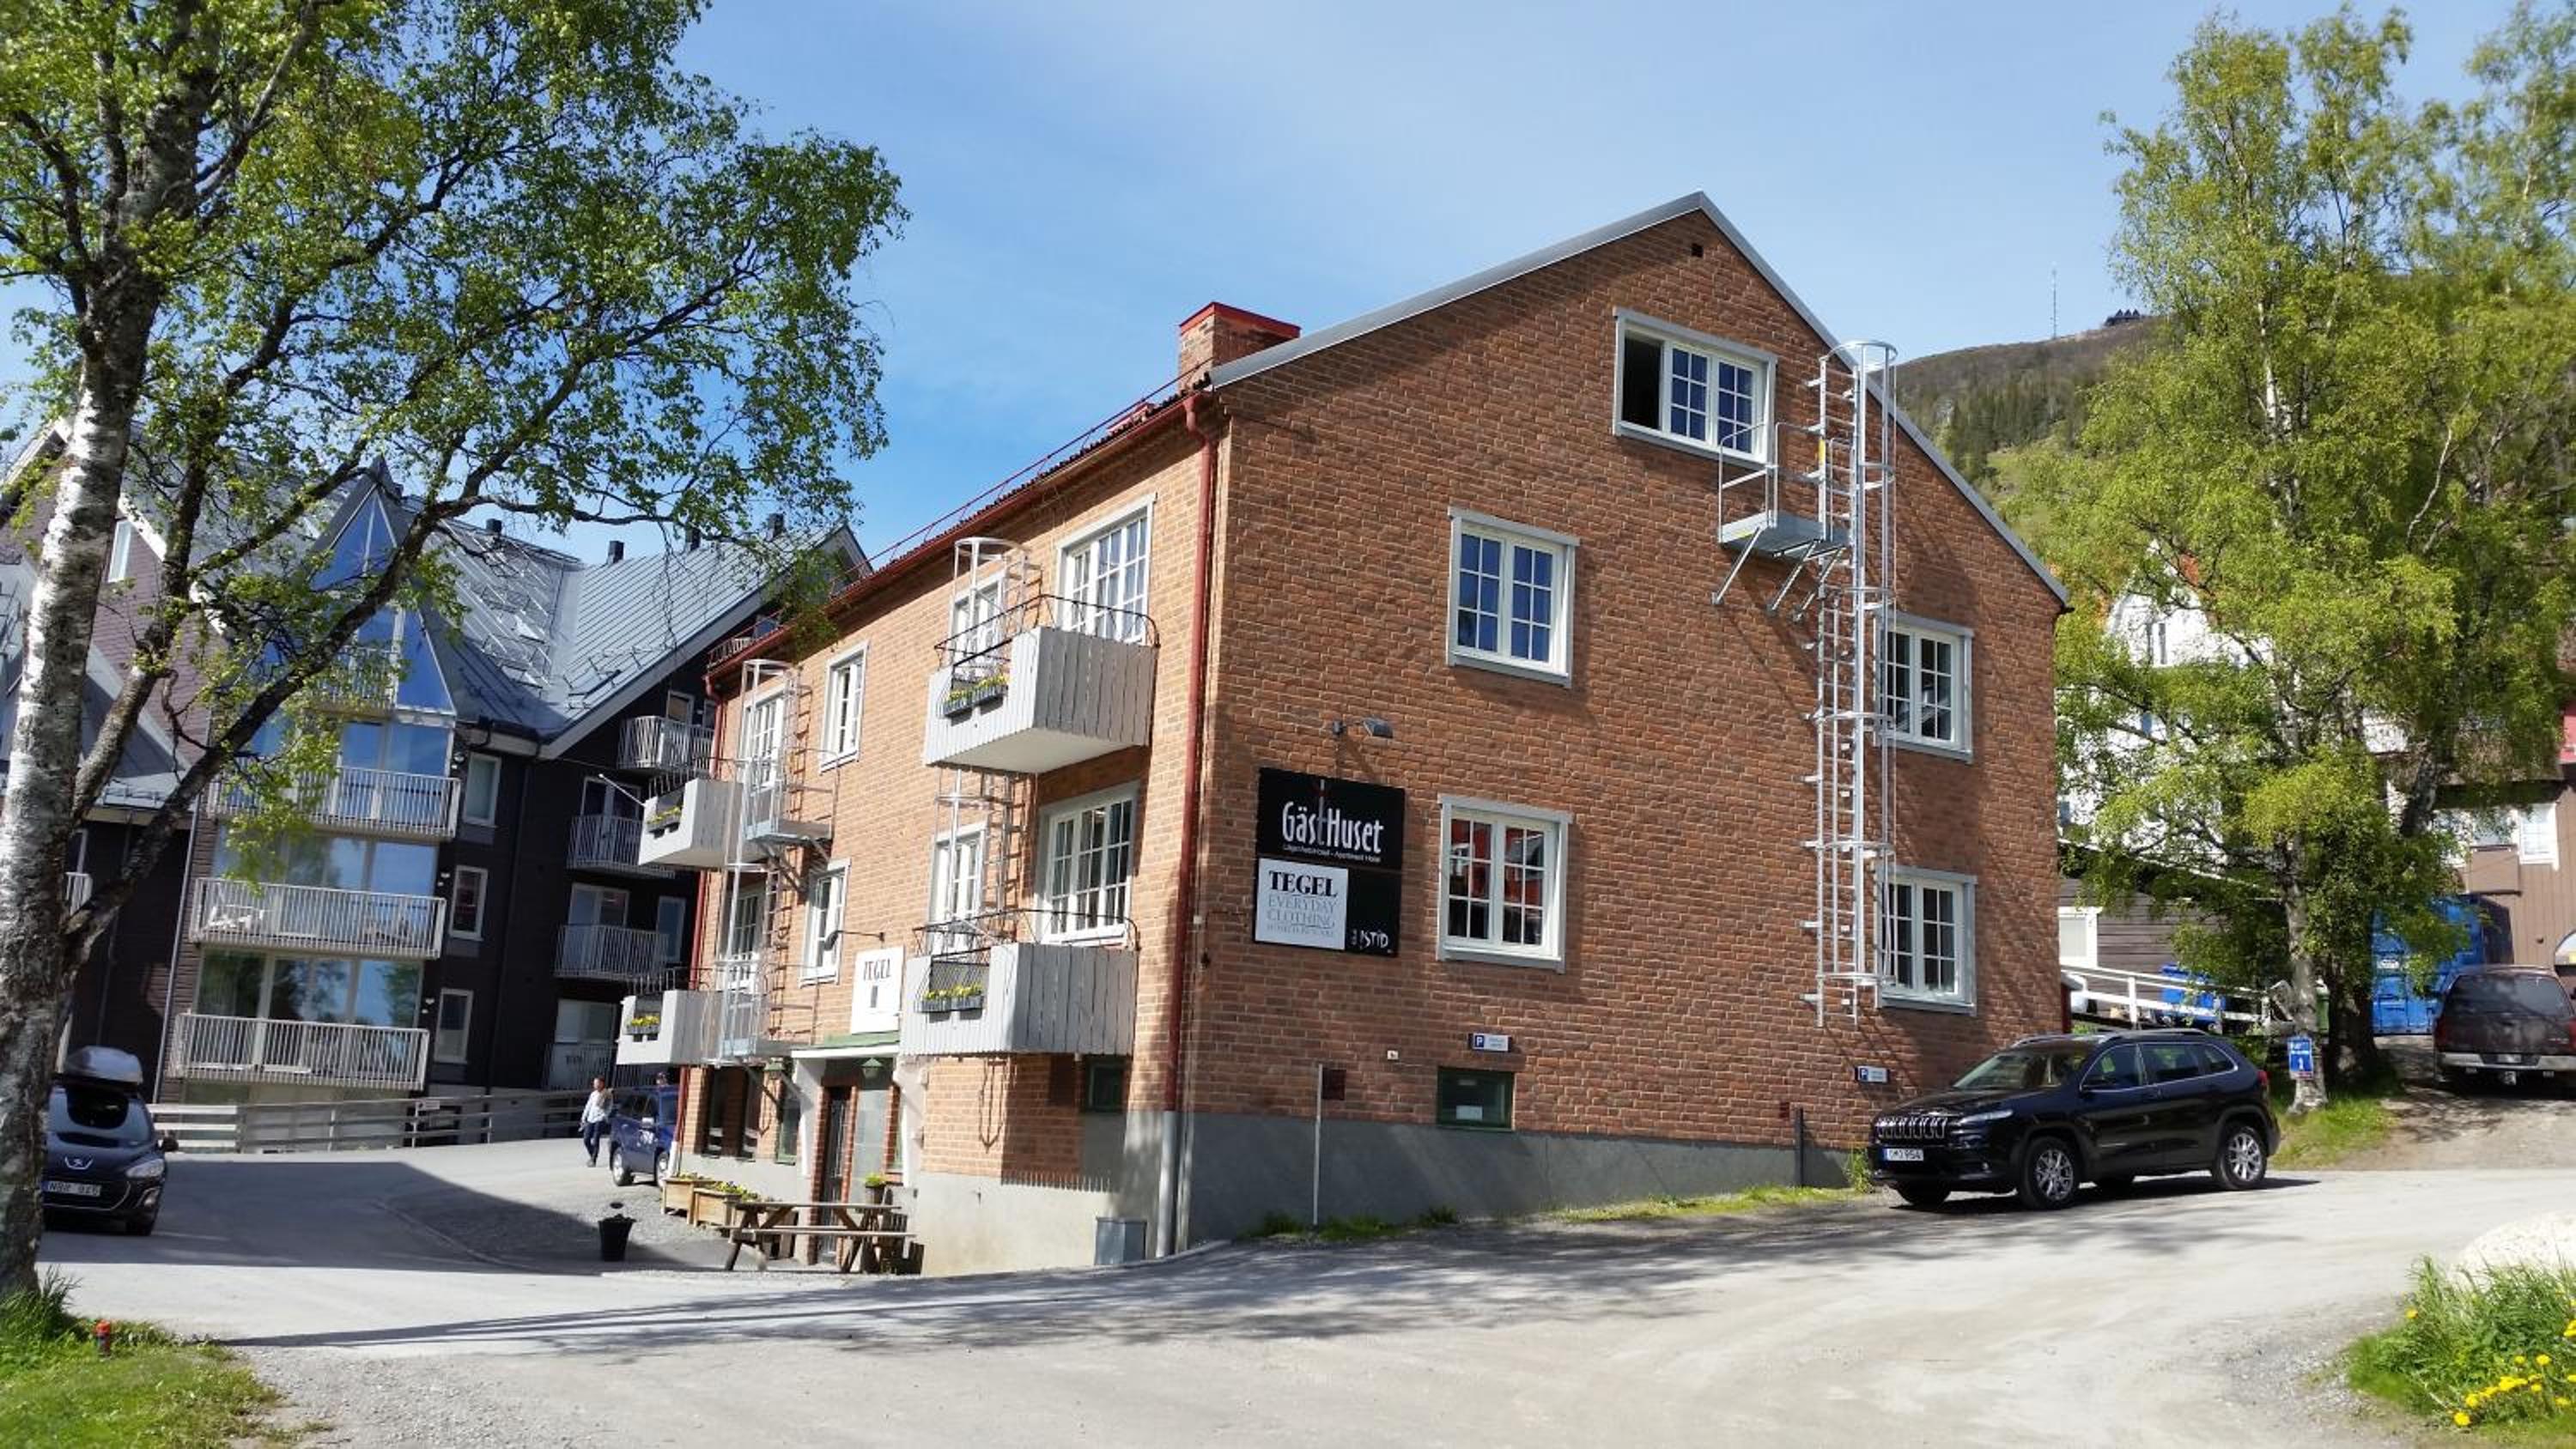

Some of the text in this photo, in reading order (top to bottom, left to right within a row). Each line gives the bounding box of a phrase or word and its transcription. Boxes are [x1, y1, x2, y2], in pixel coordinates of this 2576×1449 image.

[1282, 797, 1384, 853] GästHuset
[1268, 870, 1339, 898] TEGEL
[1268, 894, 1339, 914] EVERYDAY
[1267, 910, 1336, 930] CLOTHING
